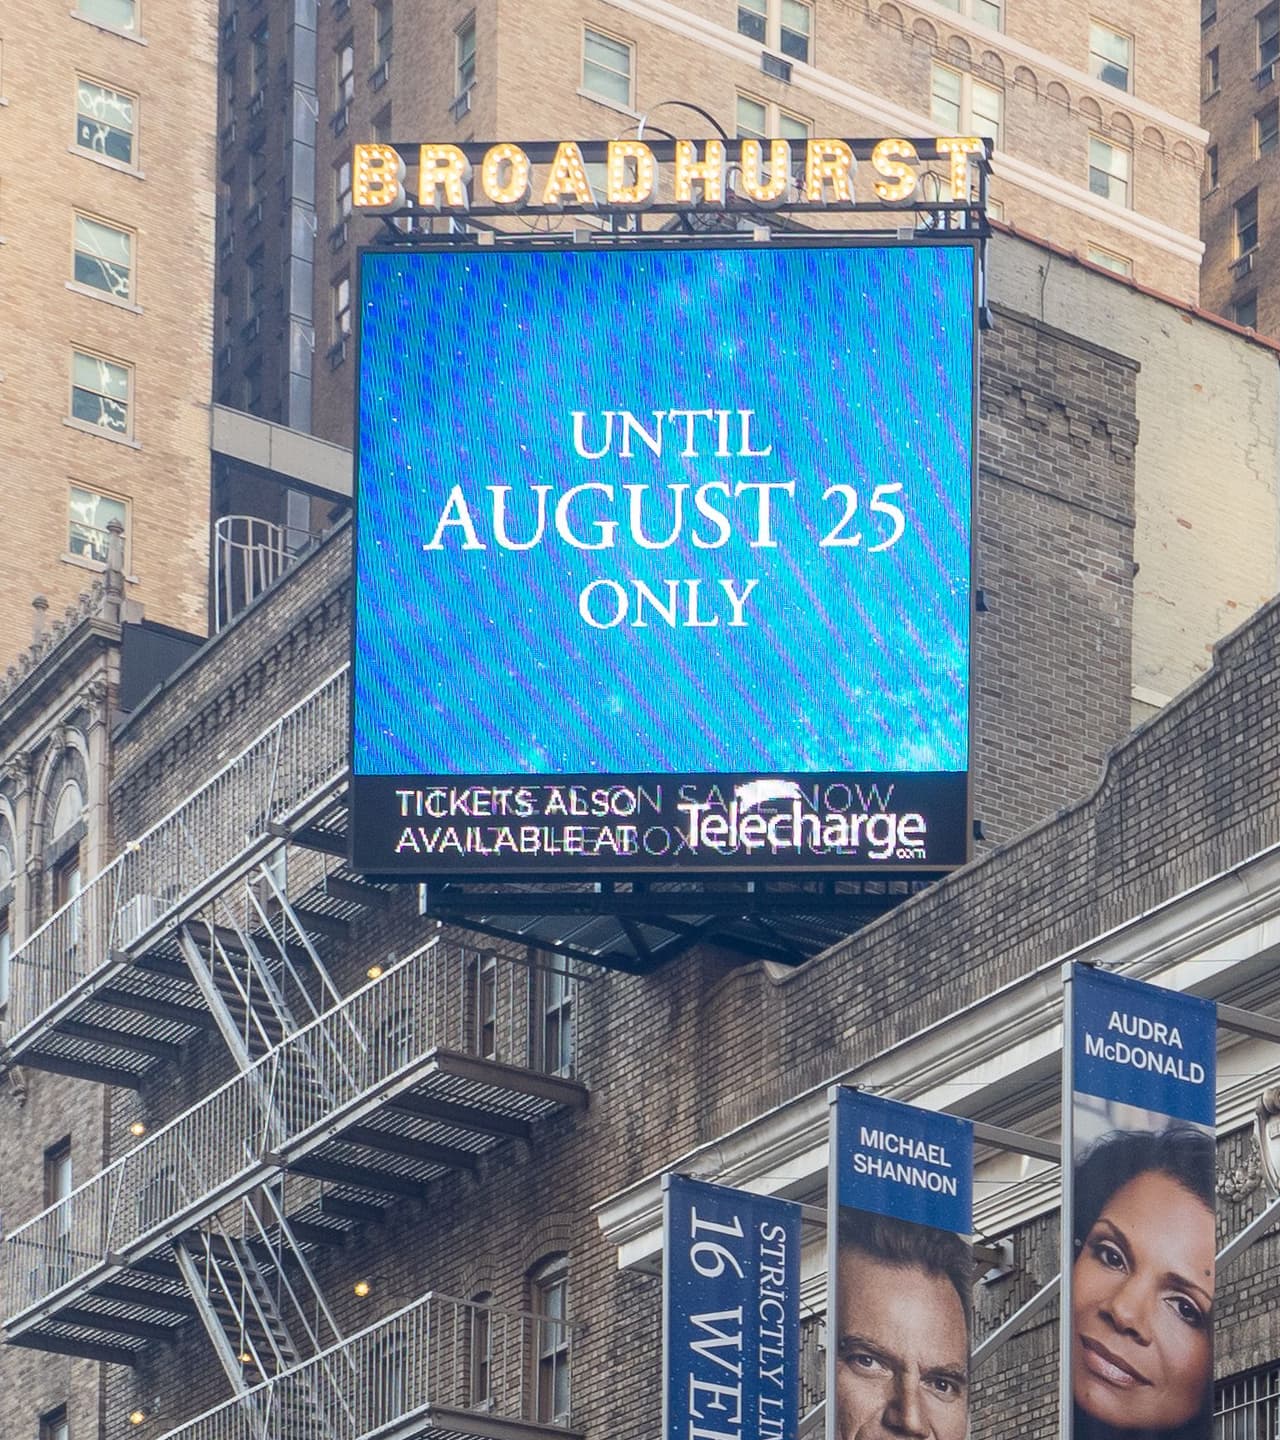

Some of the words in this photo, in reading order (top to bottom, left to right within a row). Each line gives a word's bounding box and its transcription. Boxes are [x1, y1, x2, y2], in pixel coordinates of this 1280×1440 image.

[353, 138, 984, 208] BROADHURST
[572, 409, 772, 459] UNTIL
[423, 481, 797, 551] AUGUST
[818, 481, 905, 552] 25
[578, 578, 760, 630] ONLY
[396, 789, 533, 818] TICKETS
[544, 789, 637, 818] ALSO
[677, 800, 927, 859] Telecharge
[395, 825, 583, 854] AVAILABLE
[1107, 1009, 1184, 1050] AUDRA
[1084, 1033, 1206, 1086] McDONALD
[859, 1126, 954, 1169] MICHAEL
[853, 1151, 958, 1198] SHANNON
[689, 1206, 746, 1280] 16
[757, 1221, 788, 1383] STRICTLY
